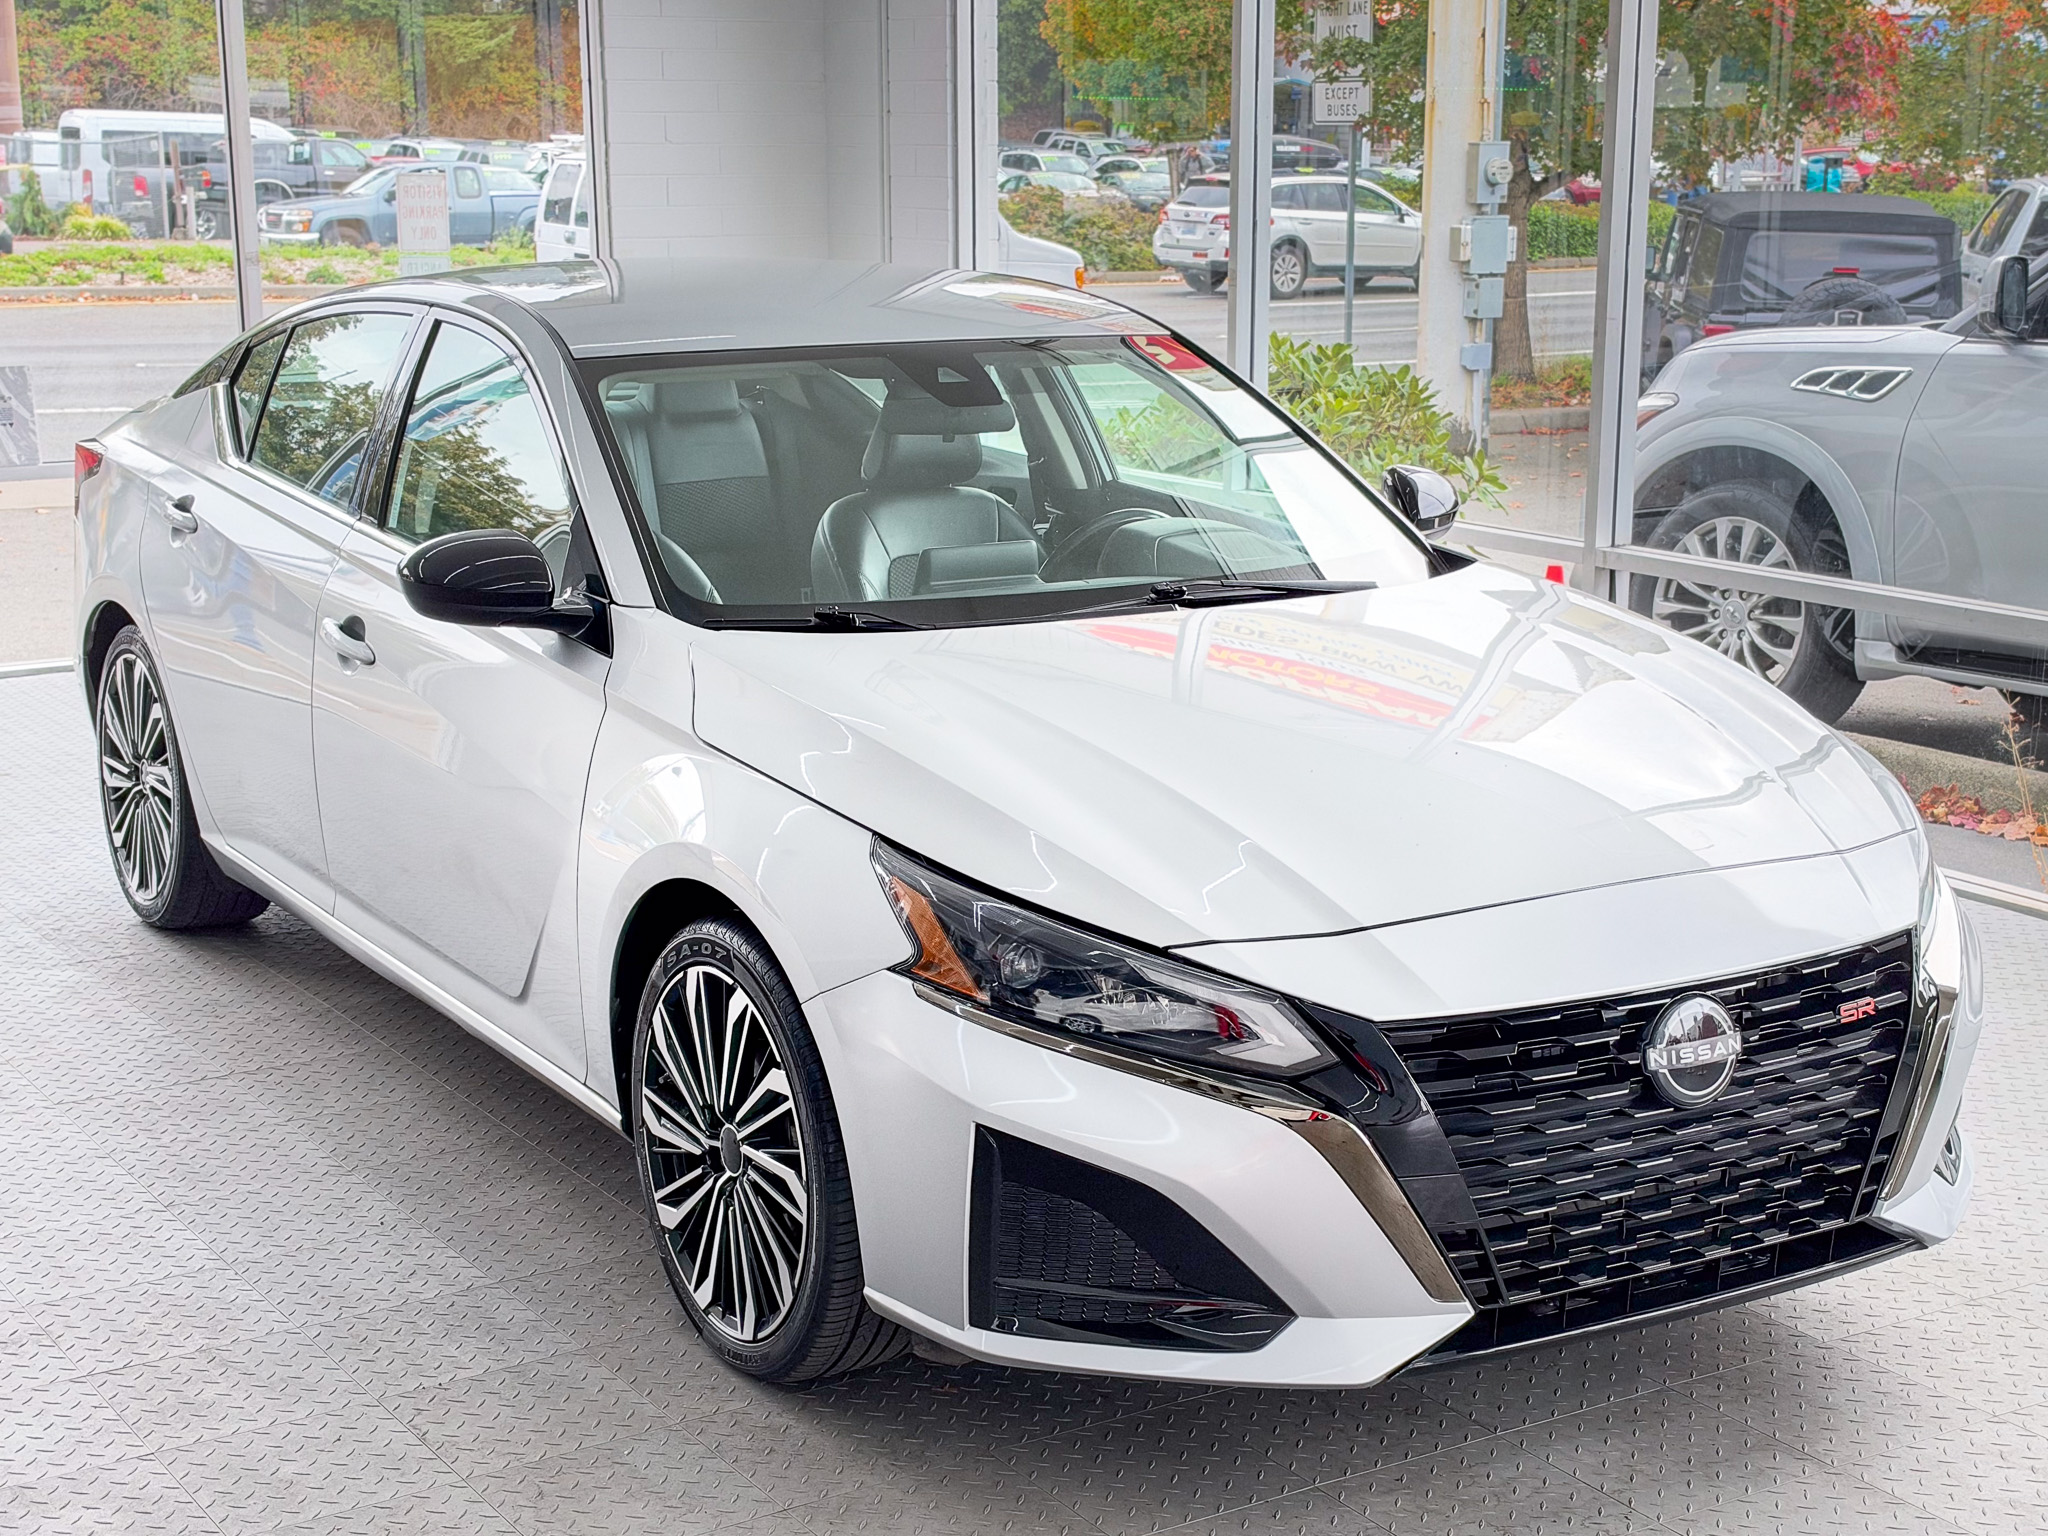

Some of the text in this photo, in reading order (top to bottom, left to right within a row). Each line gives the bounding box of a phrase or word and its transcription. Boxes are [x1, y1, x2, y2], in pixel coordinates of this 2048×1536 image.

[1347, 1, 1368, 15] LANE
[1325, 87, 1360, 100] EXCEPT
[1327, 104, 1358, 117] BUSES
[667, 942, 727, 967] SA-07
[1840, 997, 1876, 1024] SR
[1650, 1034, 1742, 1068] NISSAN
